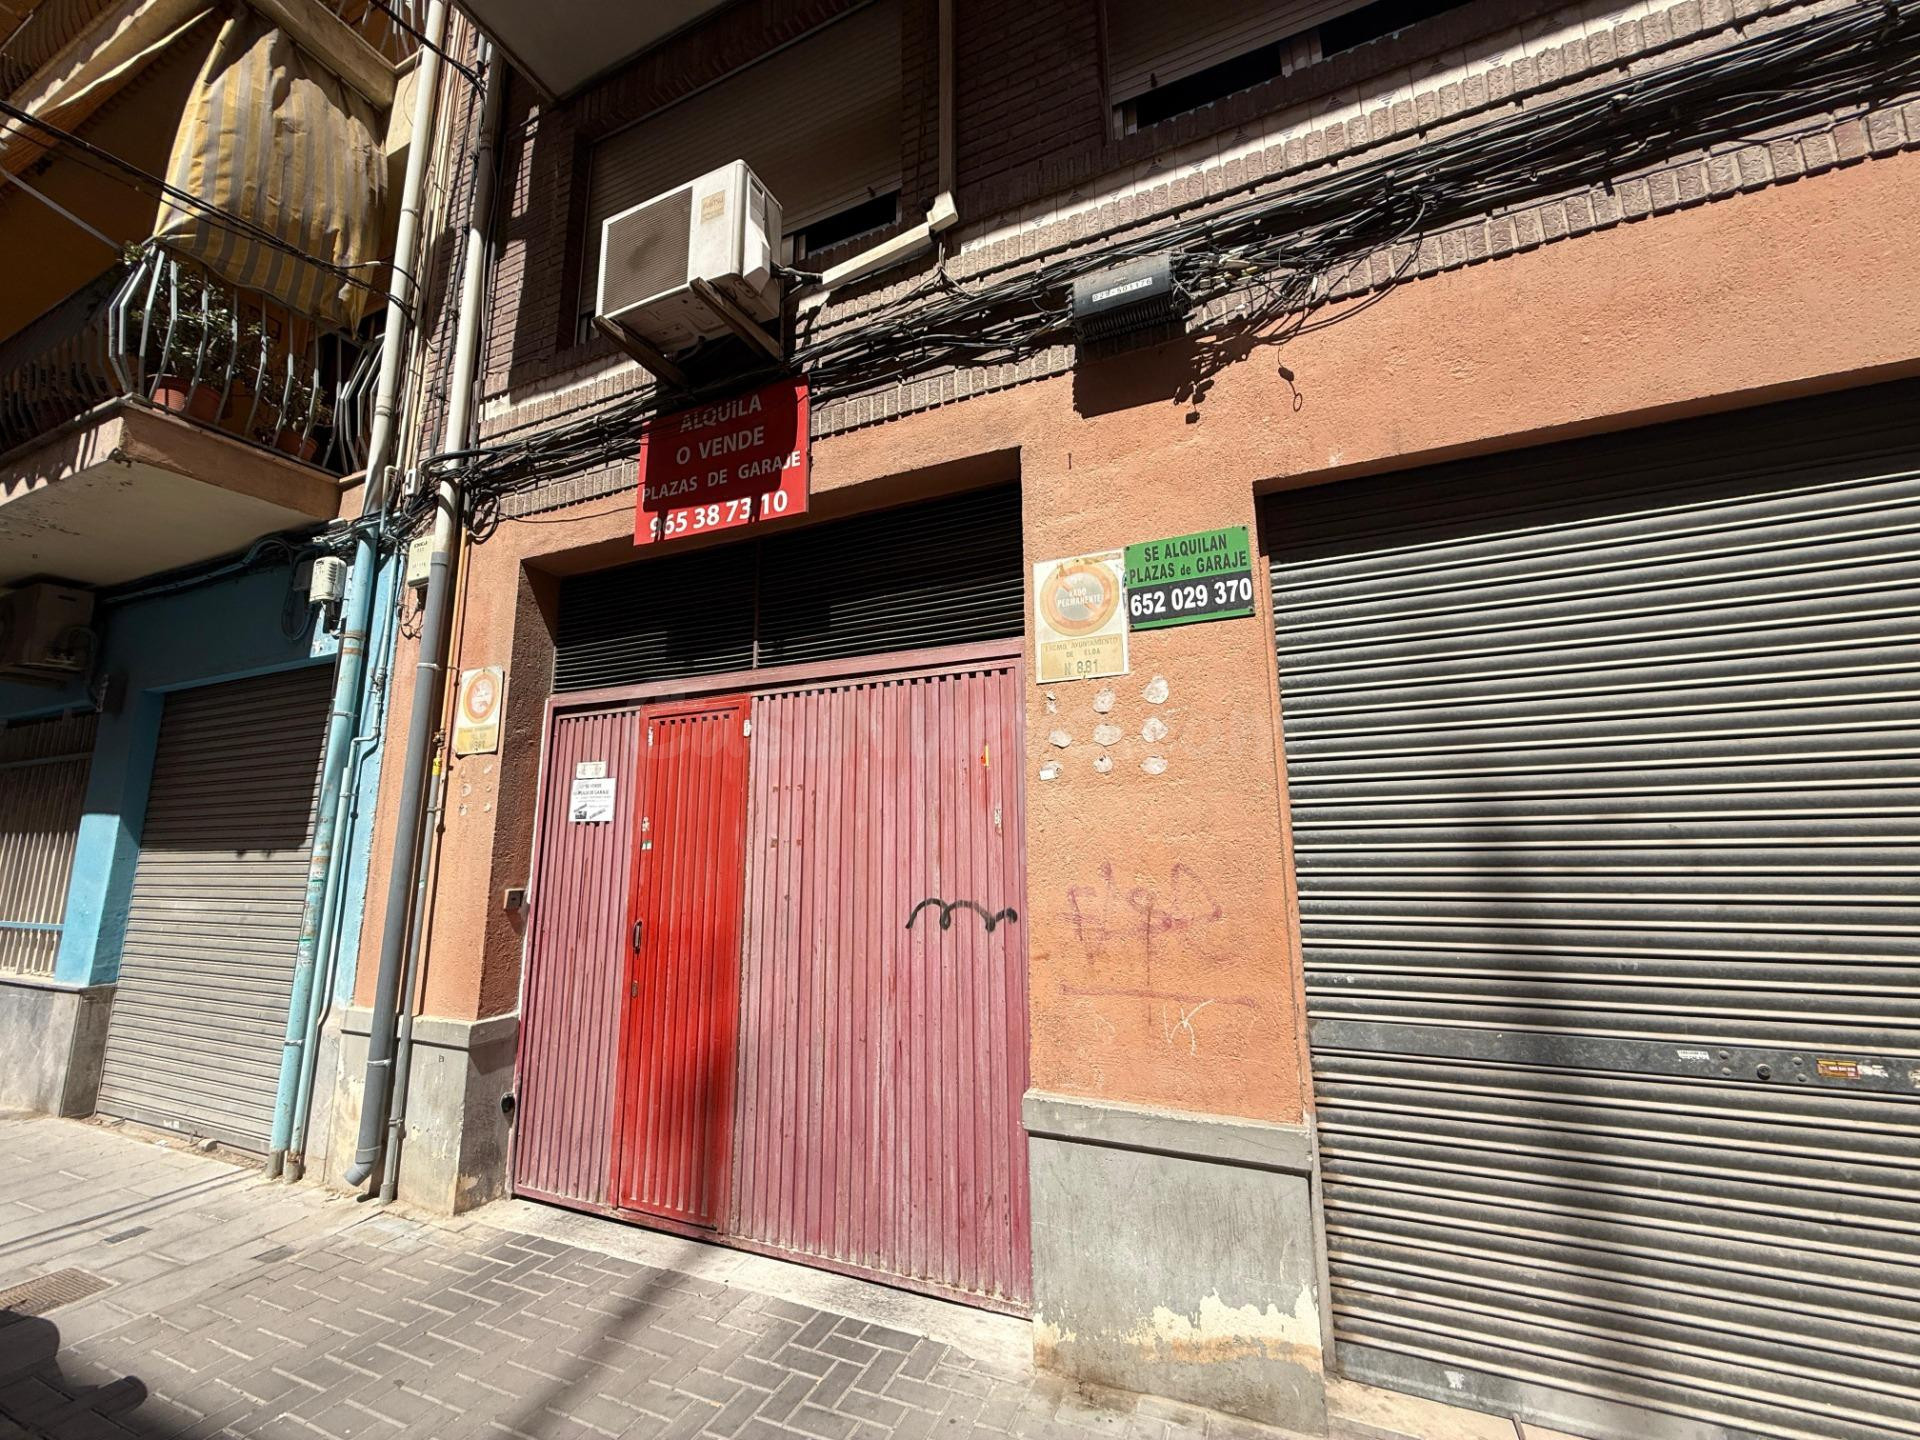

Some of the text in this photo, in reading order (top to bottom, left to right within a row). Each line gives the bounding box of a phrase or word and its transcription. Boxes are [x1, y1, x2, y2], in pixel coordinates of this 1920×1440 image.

[680, 393, 762, 432] ALQUILA
[676, 426, 765, 465] O VENDE
[644, 451, 801, 501] PLAZAS DE GARAJE
[650, 489, 788, 537] 965 38 73 10
[1129, 550, 1248, 585] PLAZAS de GARAJE
[1144, 533, 1227, 563] SE ALQUILAN
[1130, 577, 1252, 617] 652 029 370
[1076, 659, 1098, 674] 881
